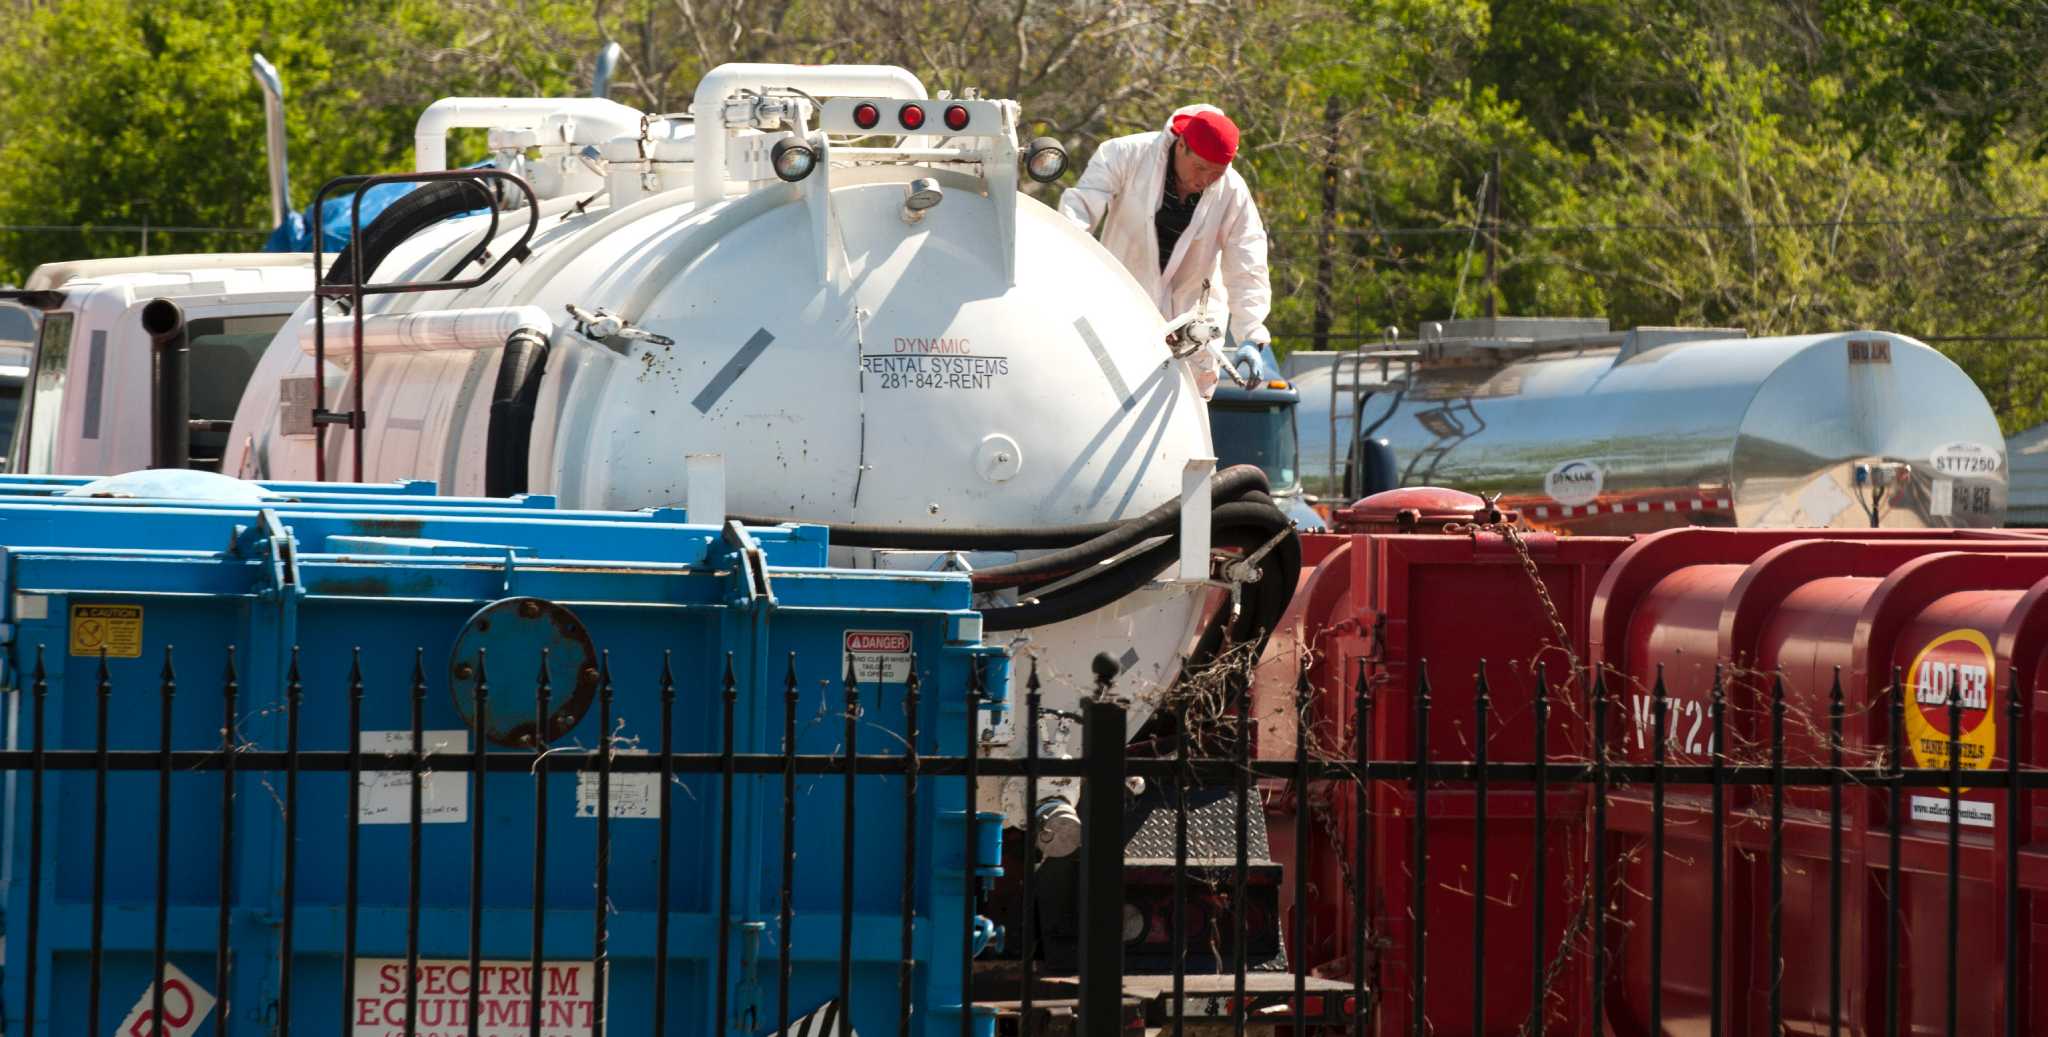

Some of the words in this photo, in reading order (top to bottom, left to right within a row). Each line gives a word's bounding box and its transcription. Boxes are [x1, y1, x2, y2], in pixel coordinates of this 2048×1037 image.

[894, 337, 970, 354] DYNAMIC
[863, 357, 927, 373] RENTAL
[931, 358, 1009, 375] SYSTEMS
[881, 373, 992, 389] 281-842-RENT
[1936, 456, 1994, 472] STT7250
[862, 636, 905, 649] DANGER
